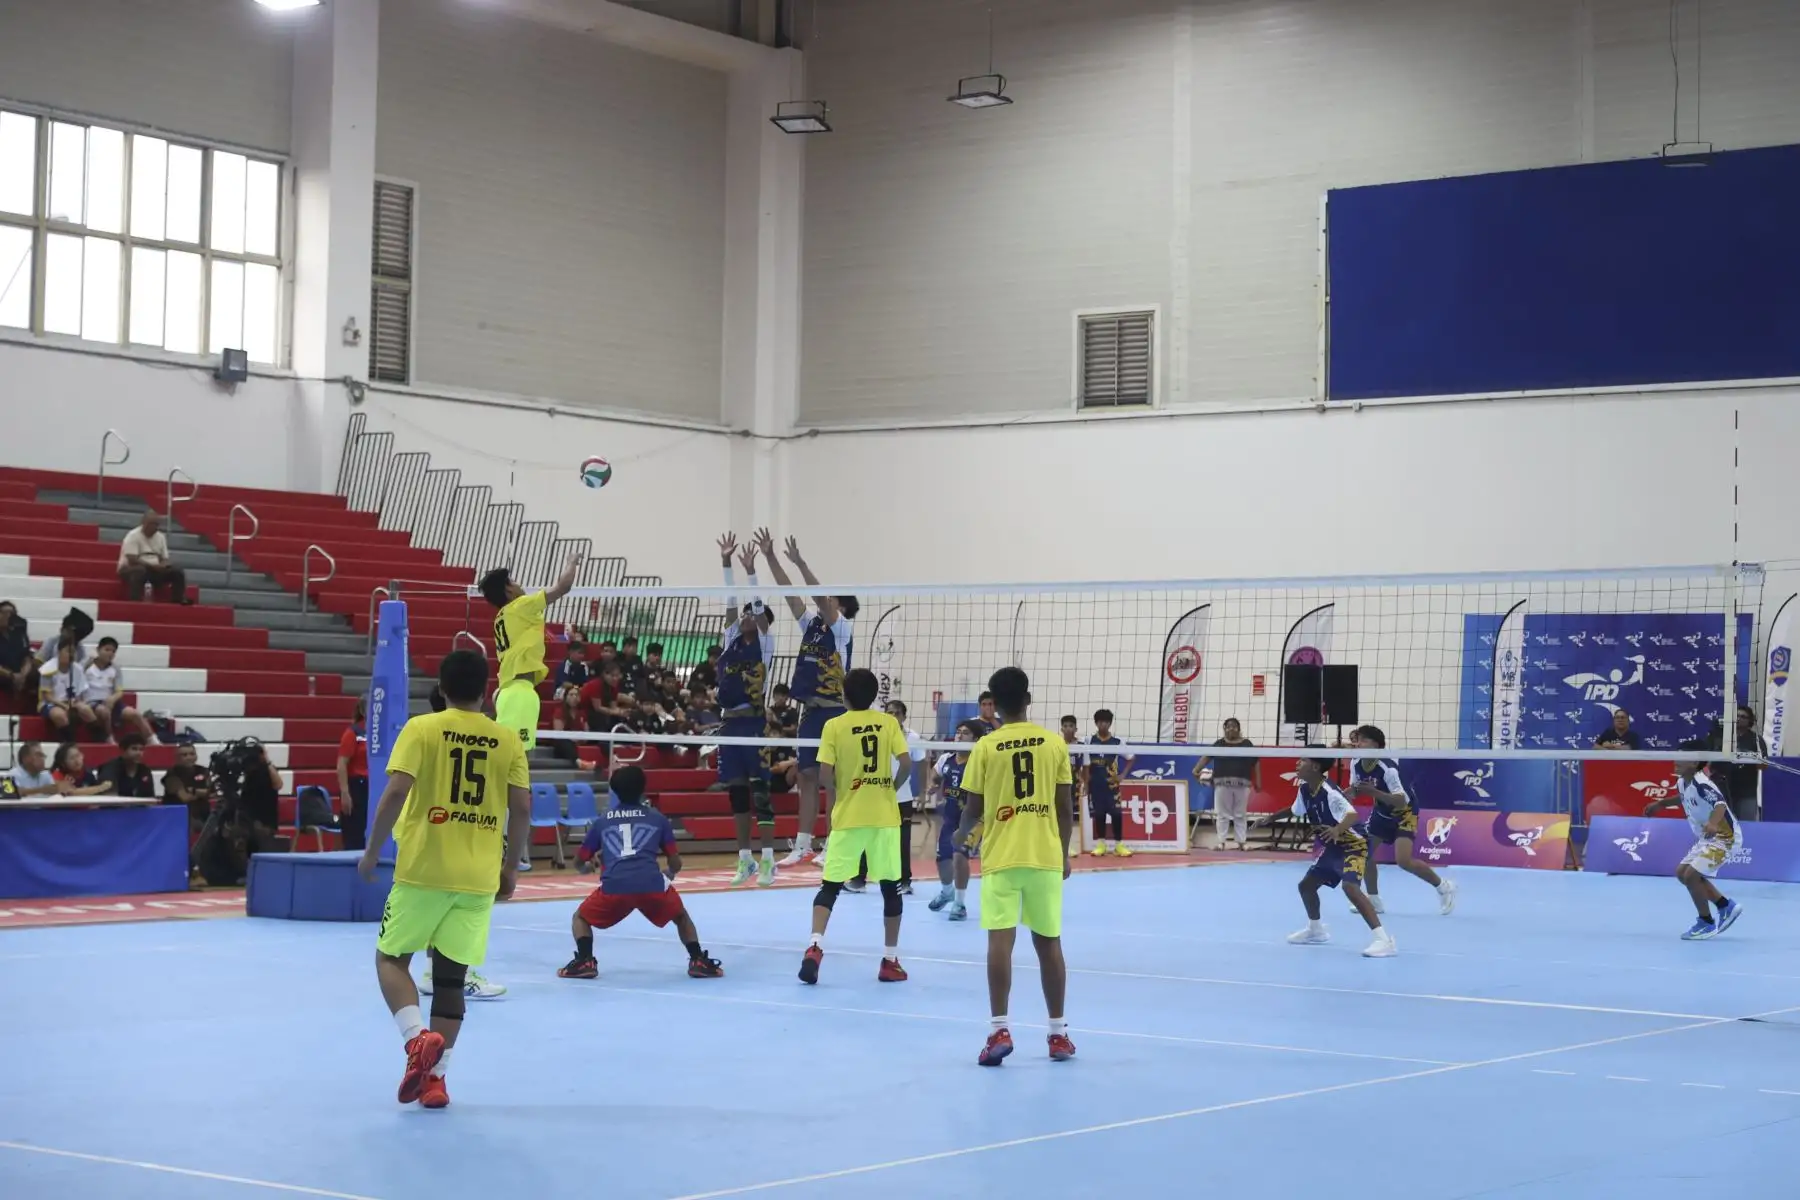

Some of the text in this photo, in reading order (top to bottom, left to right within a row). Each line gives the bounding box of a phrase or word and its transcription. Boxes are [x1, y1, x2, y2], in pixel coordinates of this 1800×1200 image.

[1584, 684, 1620, 701] IPD
[372, 703, 382, 754] Senoh
[852, 724, 882, 735] RAY
[442, 730, 499, 749] TINOCO
[996, 737, 1045, 751] GERARD
[861, 735, 878, 773] 9
[450, 747, 488, 806] 15
[1012, 750, 1035, 800] 8
[1464, 776, 1483, 786] IPD
[1644, 787, 1668, 798] IPD
[450, 811, 497, 826] FAGUM
[607, 810, 646, 819] DANIEL
[619, 823, 636, 857] 1
[1516, 838, 1532, 846] IPD
[1620, 843, 1637, 851] IPD
[1420, 846, 1452, 855] Academia
